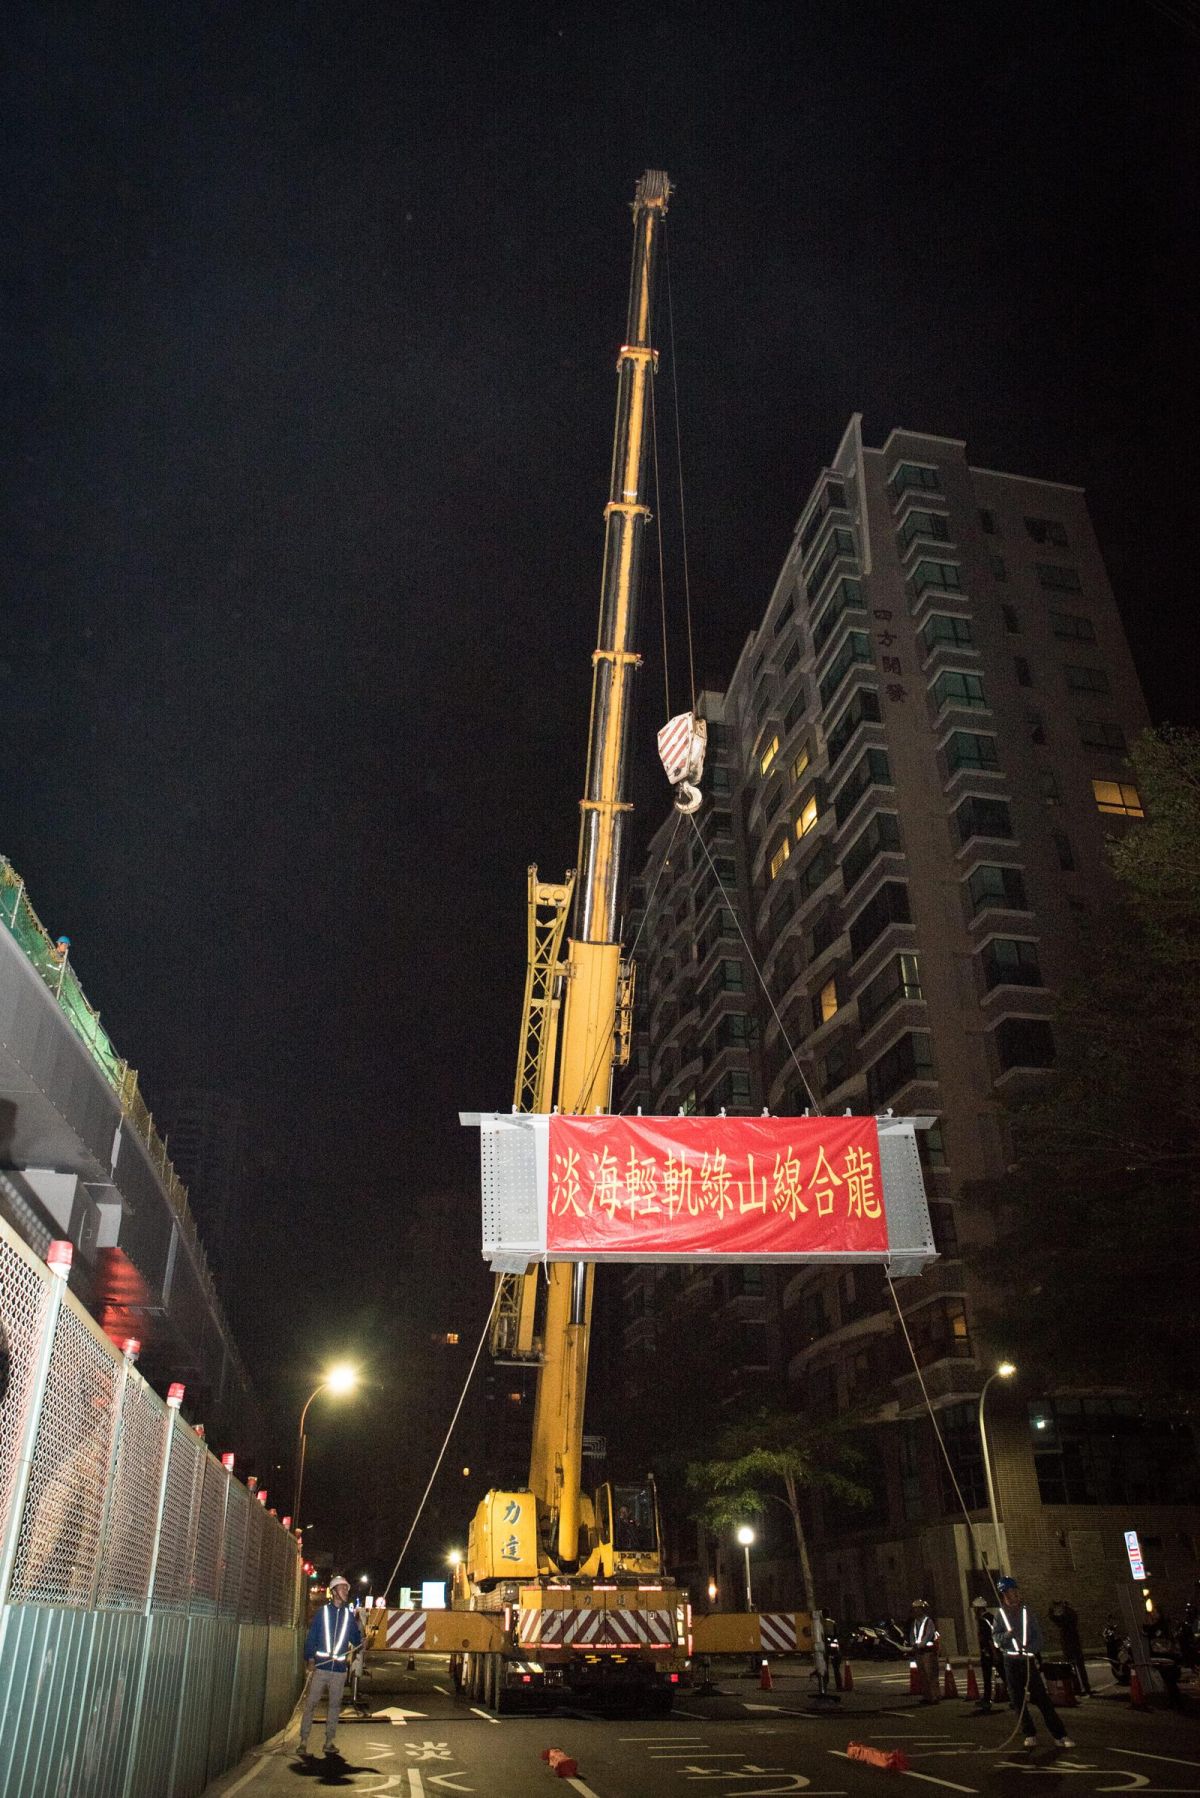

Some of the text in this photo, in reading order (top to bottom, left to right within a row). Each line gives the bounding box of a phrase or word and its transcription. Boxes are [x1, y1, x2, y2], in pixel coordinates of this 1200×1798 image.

[551, 1145, 882, 1222] 淡海輕軌綠山線合龍
